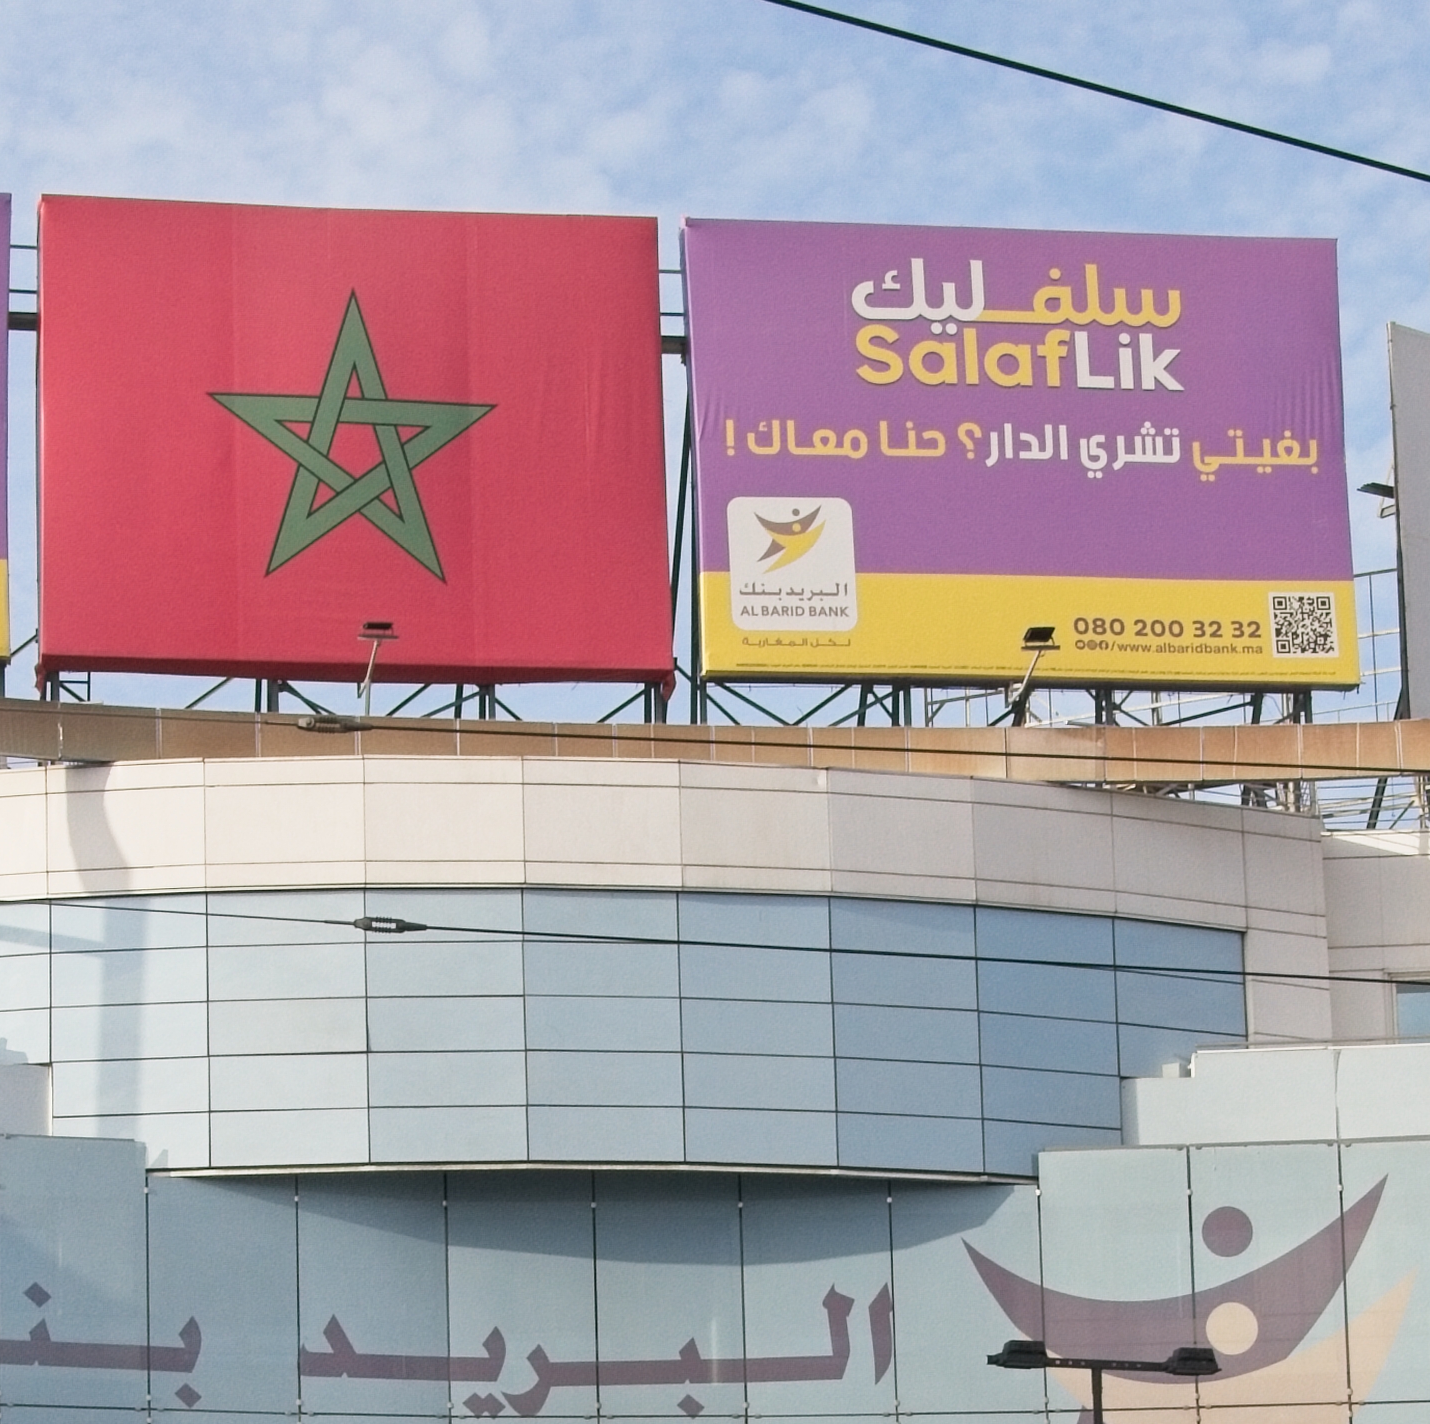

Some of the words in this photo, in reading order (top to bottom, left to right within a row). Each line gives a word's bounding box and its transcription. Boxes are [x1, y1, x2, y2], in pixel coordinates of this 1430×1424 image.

[851, 258, 1181, 335] سلفليك
[855, 324, 1185, 391] SalafLik
[747, 418, 869, 459] معاك
[879, 419, 946, 458] حنا
[1079, 420, 1181, 479] تشري
[1192, 427, 1319, 482] بغيتي
[739, 582, 782, 602] بنك
[740, 605, 759, 617] AL
[761, 605, 805, 617] BARID
[809, 606, 850, 618] BANK
[786, 583, 848, 602] البريد
[1073, 617, 1125, 636] 080
[1133, 619, 1184, 637] 200
[1192, 620, 1223, 639] 32
[1231, 621, 1262, 639] 32
[299, 1281, 894, 1419] البريد
